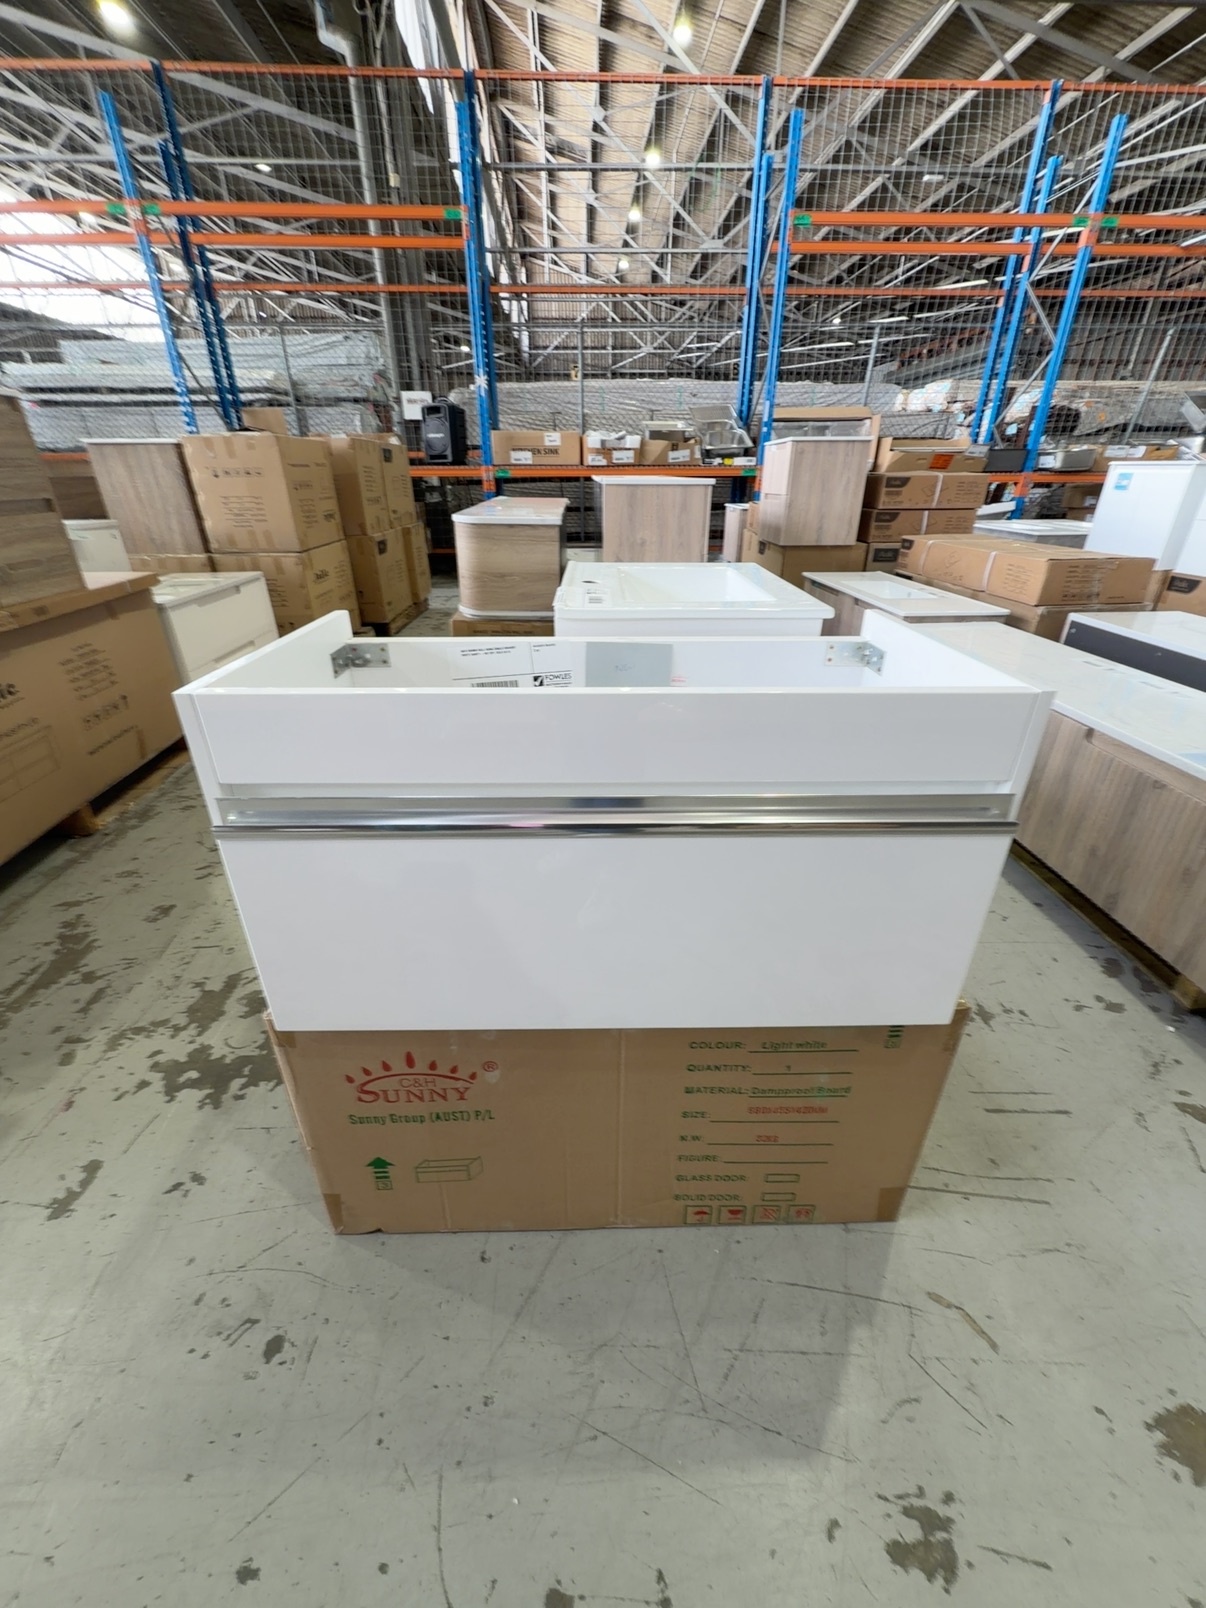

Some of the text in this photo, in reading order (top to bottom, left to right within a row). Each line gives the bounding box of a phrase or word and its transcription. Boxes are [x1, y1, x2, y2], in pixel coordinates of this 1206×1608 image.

[545, 673, 572, 681] FOWLES
[688, 1041, 746, 1049] COLOUR:
[686, 1064, 751, 1073] QUANTITY:
[400, 1077, 437, 1088] C&H
[357, 1082, 471, 1103] SUNNY
[684, 1086, 749, 1095] MATERIAL:
[348, 1110, 495, 1125] Sunny Group (AUST) P/L
[675, 1174, 712, 1182] GLASS
